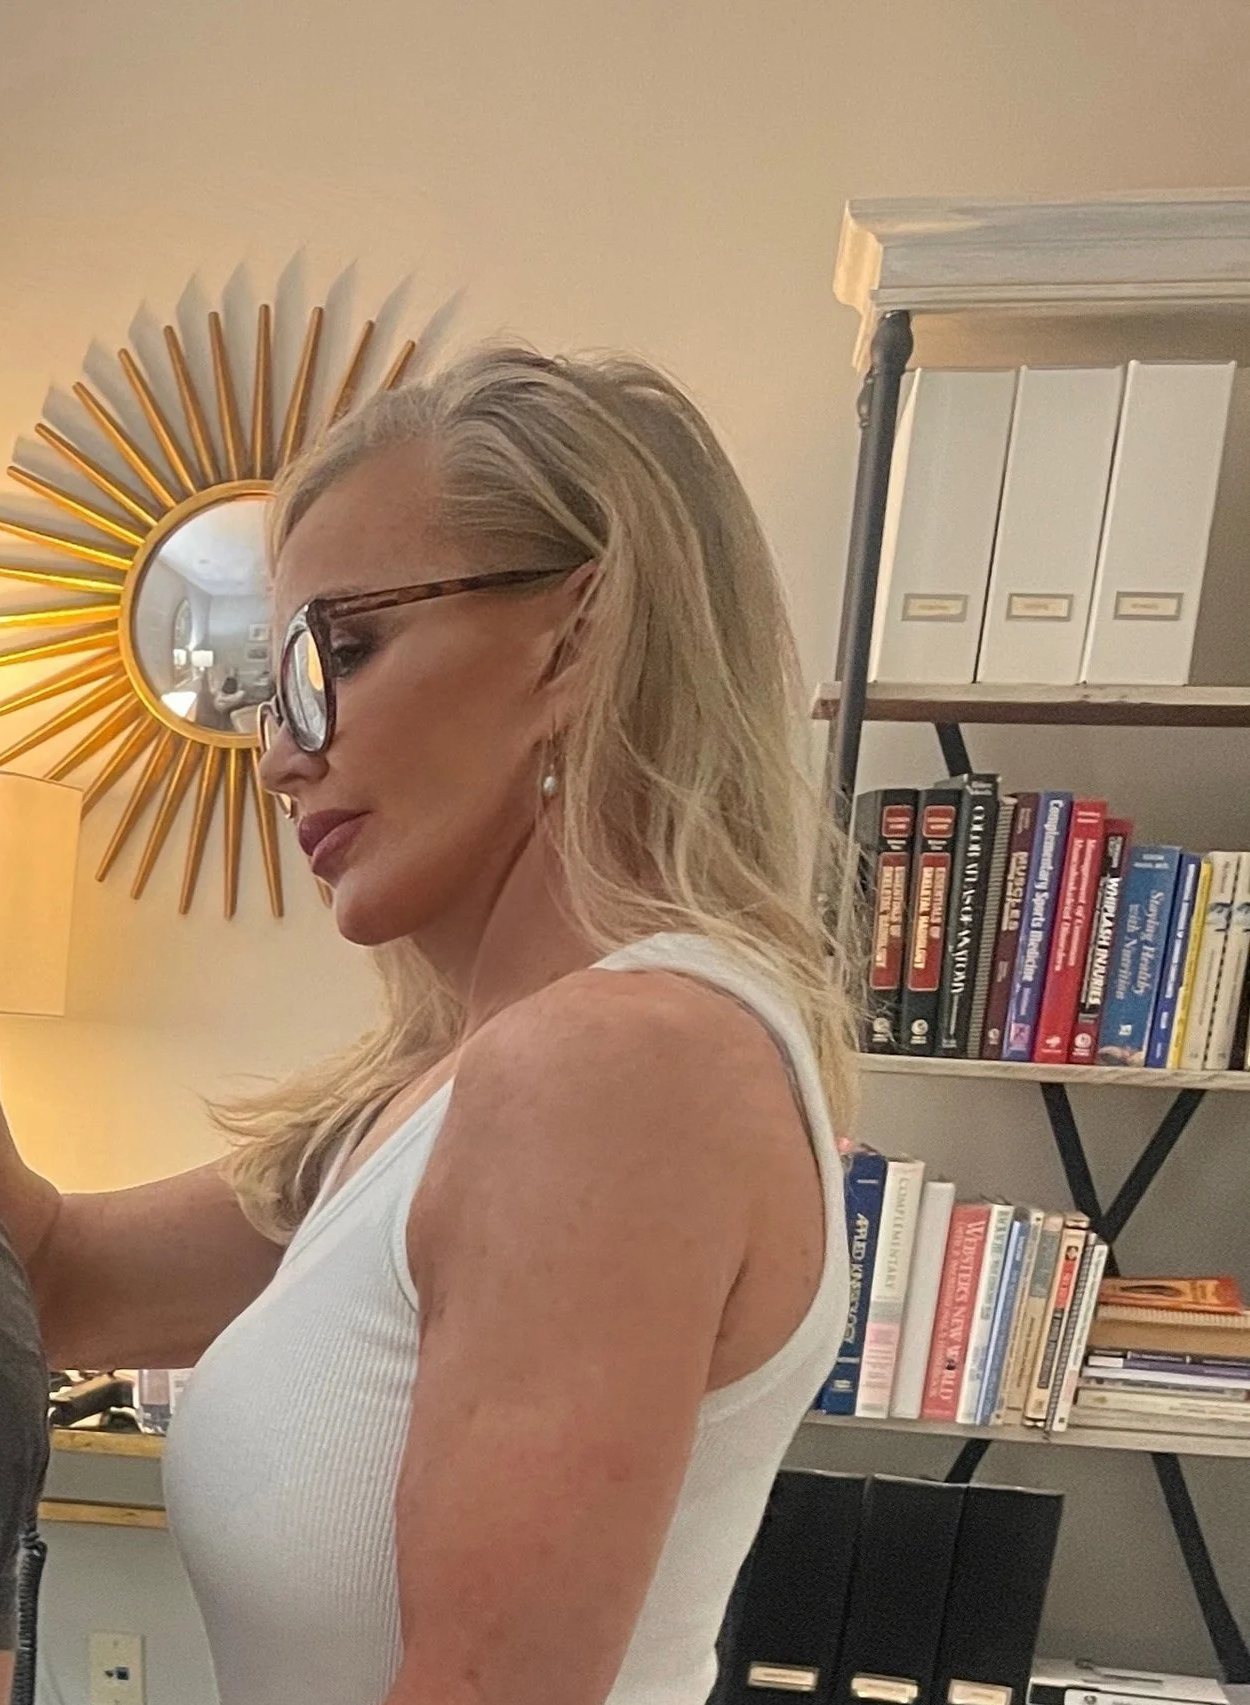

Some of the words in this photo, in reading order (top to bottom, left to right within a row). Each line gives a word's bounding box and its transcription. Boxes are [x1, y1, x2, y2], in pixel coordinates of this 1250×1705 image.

[1034, 799, 1065, 890] Complementary
[1031, 890, 1050, 929] Sports
[1098, 876, 1123, 947] WHIPLASH
[1141, 890, 1165, 943] Staying
[1022, 930, 1044, 982] Medicine
[1088, 947, 1109, 1006] INJURIES
[1115, 936, 1139, 1000] Nutrition
[1133, 944, 1156, 996] Healthy
[884, 1177, 910, 1290] COMPLEMENTARY
[949, 1304, 968, 1344] NEW
